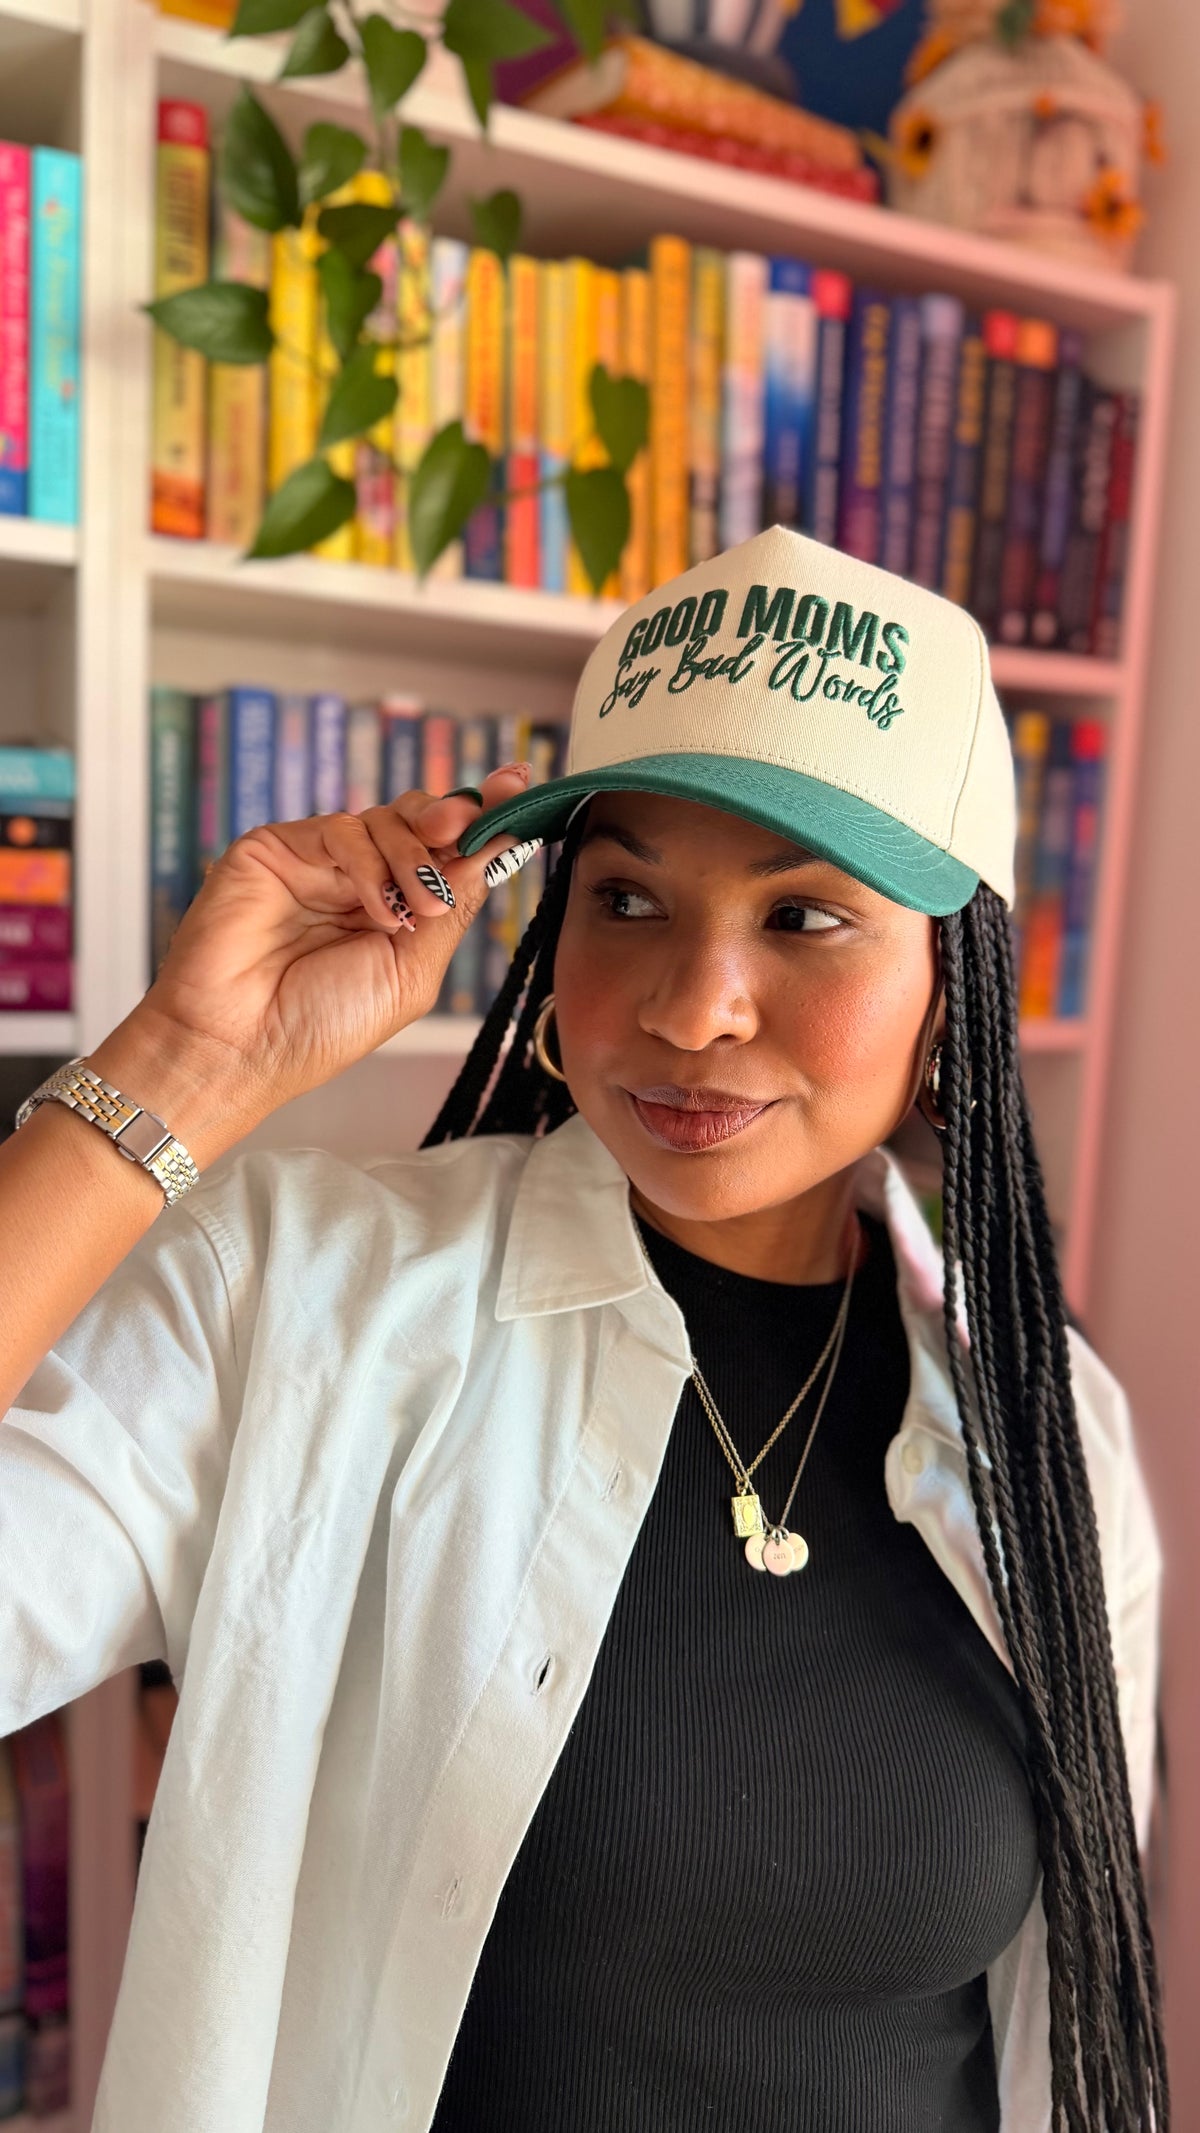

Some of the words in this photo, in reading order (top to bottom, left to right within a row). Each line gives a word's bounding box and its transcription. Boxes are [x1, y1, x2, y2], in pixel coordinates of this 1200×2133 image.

[619, 589, 729, 666] GOOD
[736, 585, 909, 674] MOMS
[600, 660, 660, 717] Say
[668, 633, 755, 693] Bad
[768, 639, 904, 730] Words
